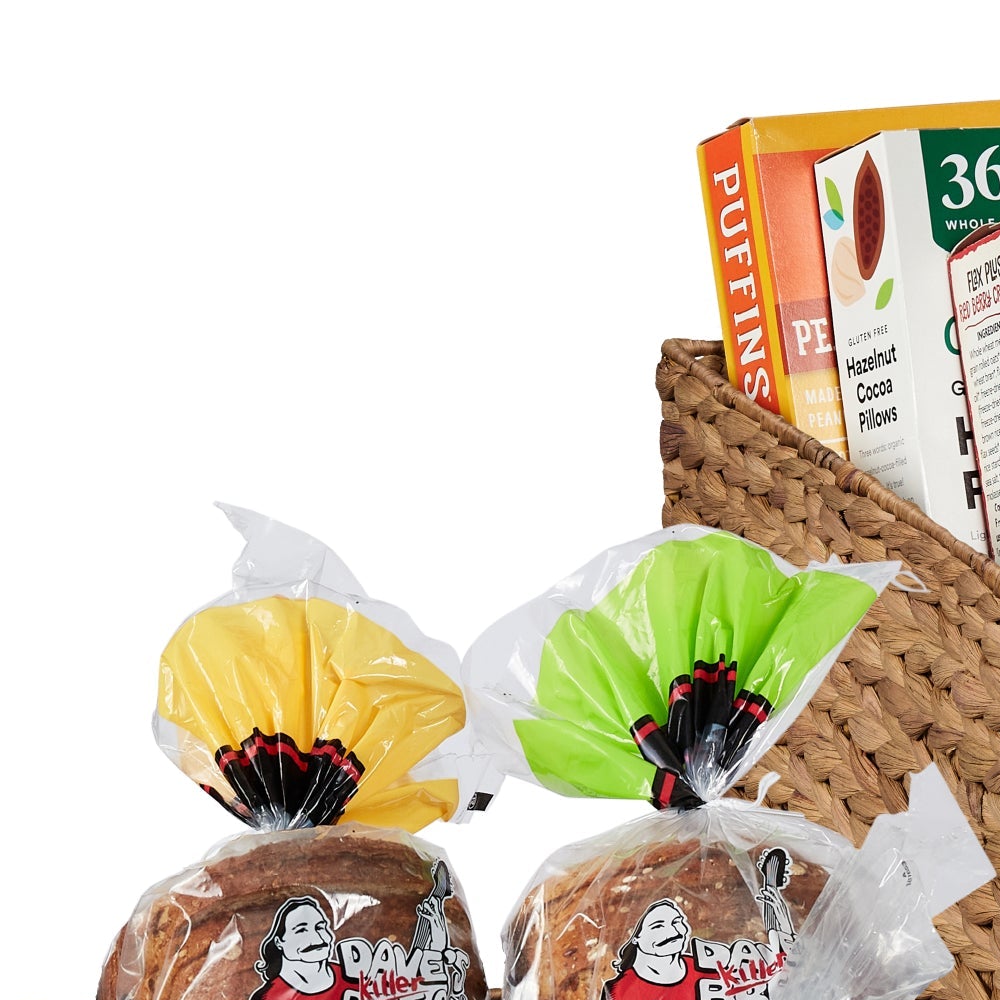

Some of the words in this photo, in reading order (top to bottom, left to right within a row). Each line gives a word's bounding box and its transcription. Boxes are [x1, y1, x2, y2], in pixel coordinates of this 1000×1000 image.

[713, 162, 769, 401] PUFFINS
[848, 330, 871, 347] GLUTEN
[873, 324, 888, 338] FREE
[846, 344, 897, 378] Hazelnut
[805, 386, 842, 405] MADE
[856, 378, 893, 404] Cocoa
[808, 411, 842, 429] PEAN
[858, 406, 898, 433] Pillows
[340, 939, 469, 994] DAVE'S
